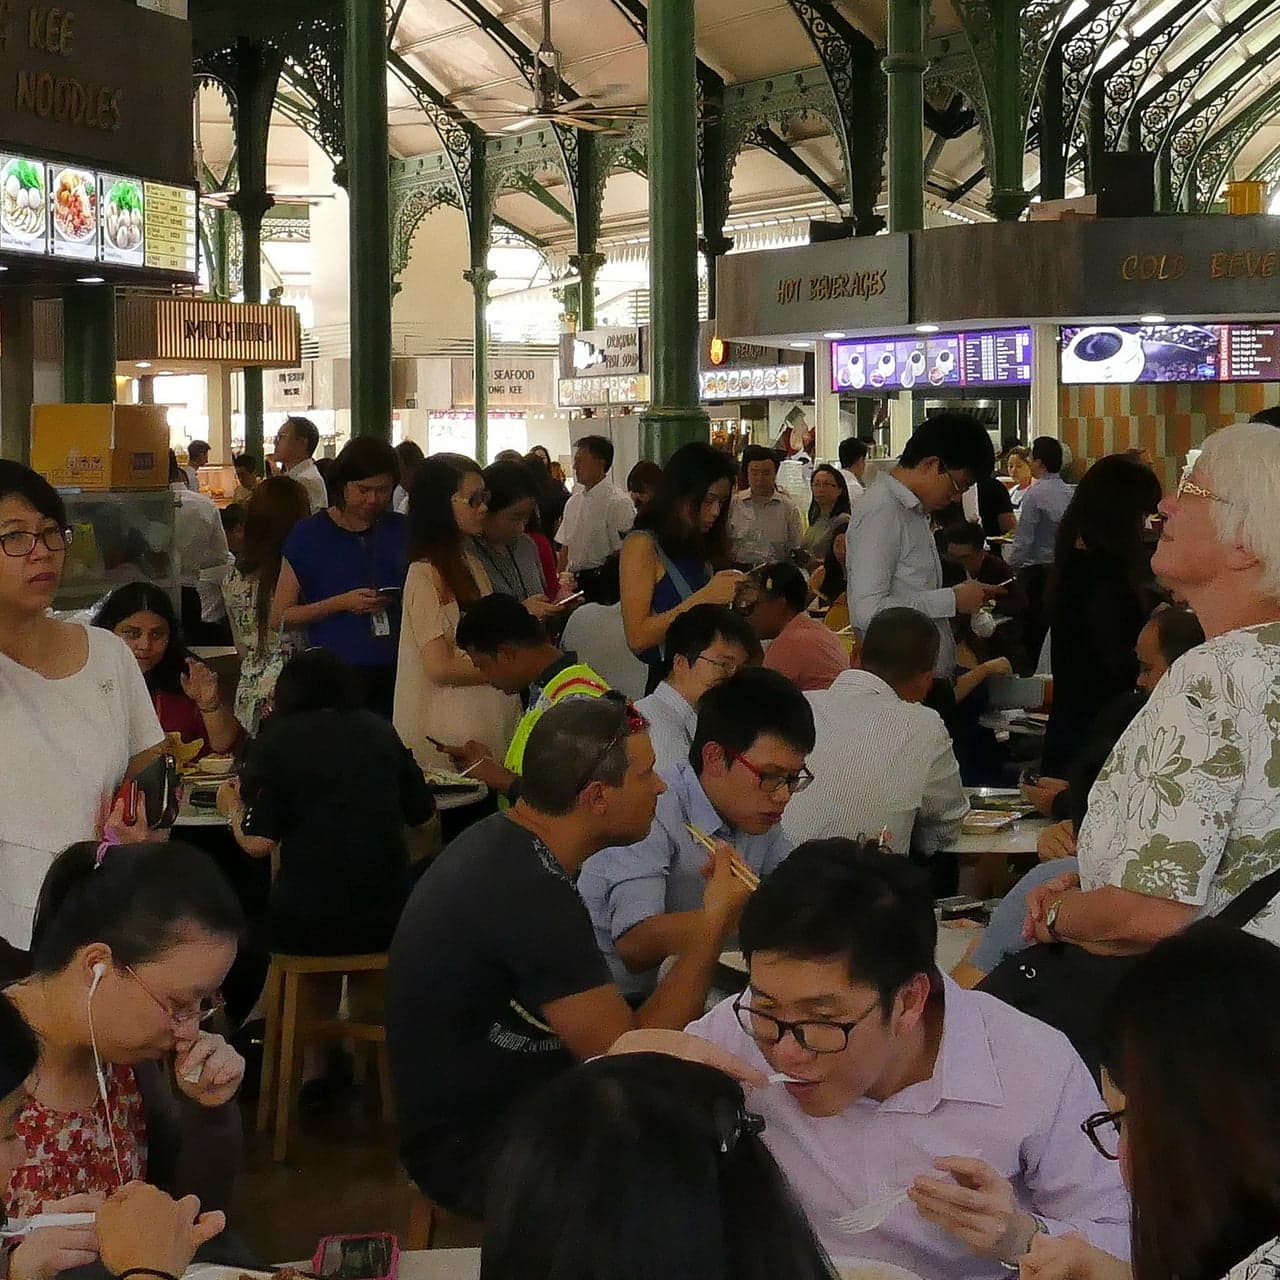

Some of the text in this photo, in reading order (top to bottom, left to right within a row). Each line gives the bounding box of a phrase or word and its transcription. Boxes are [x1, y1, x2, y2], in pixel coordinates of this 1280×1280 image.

[28, 5, 77, 56] KEE
[16, 70, 124, 129] NOODLES
[1120, 255, 1186, 281] COLD
[776, 269, 887, 305] HOT BEVERAGES
[488, 385, 523, 395] ONG KEE
[494, 369, 535, 380] SEAFOOD
